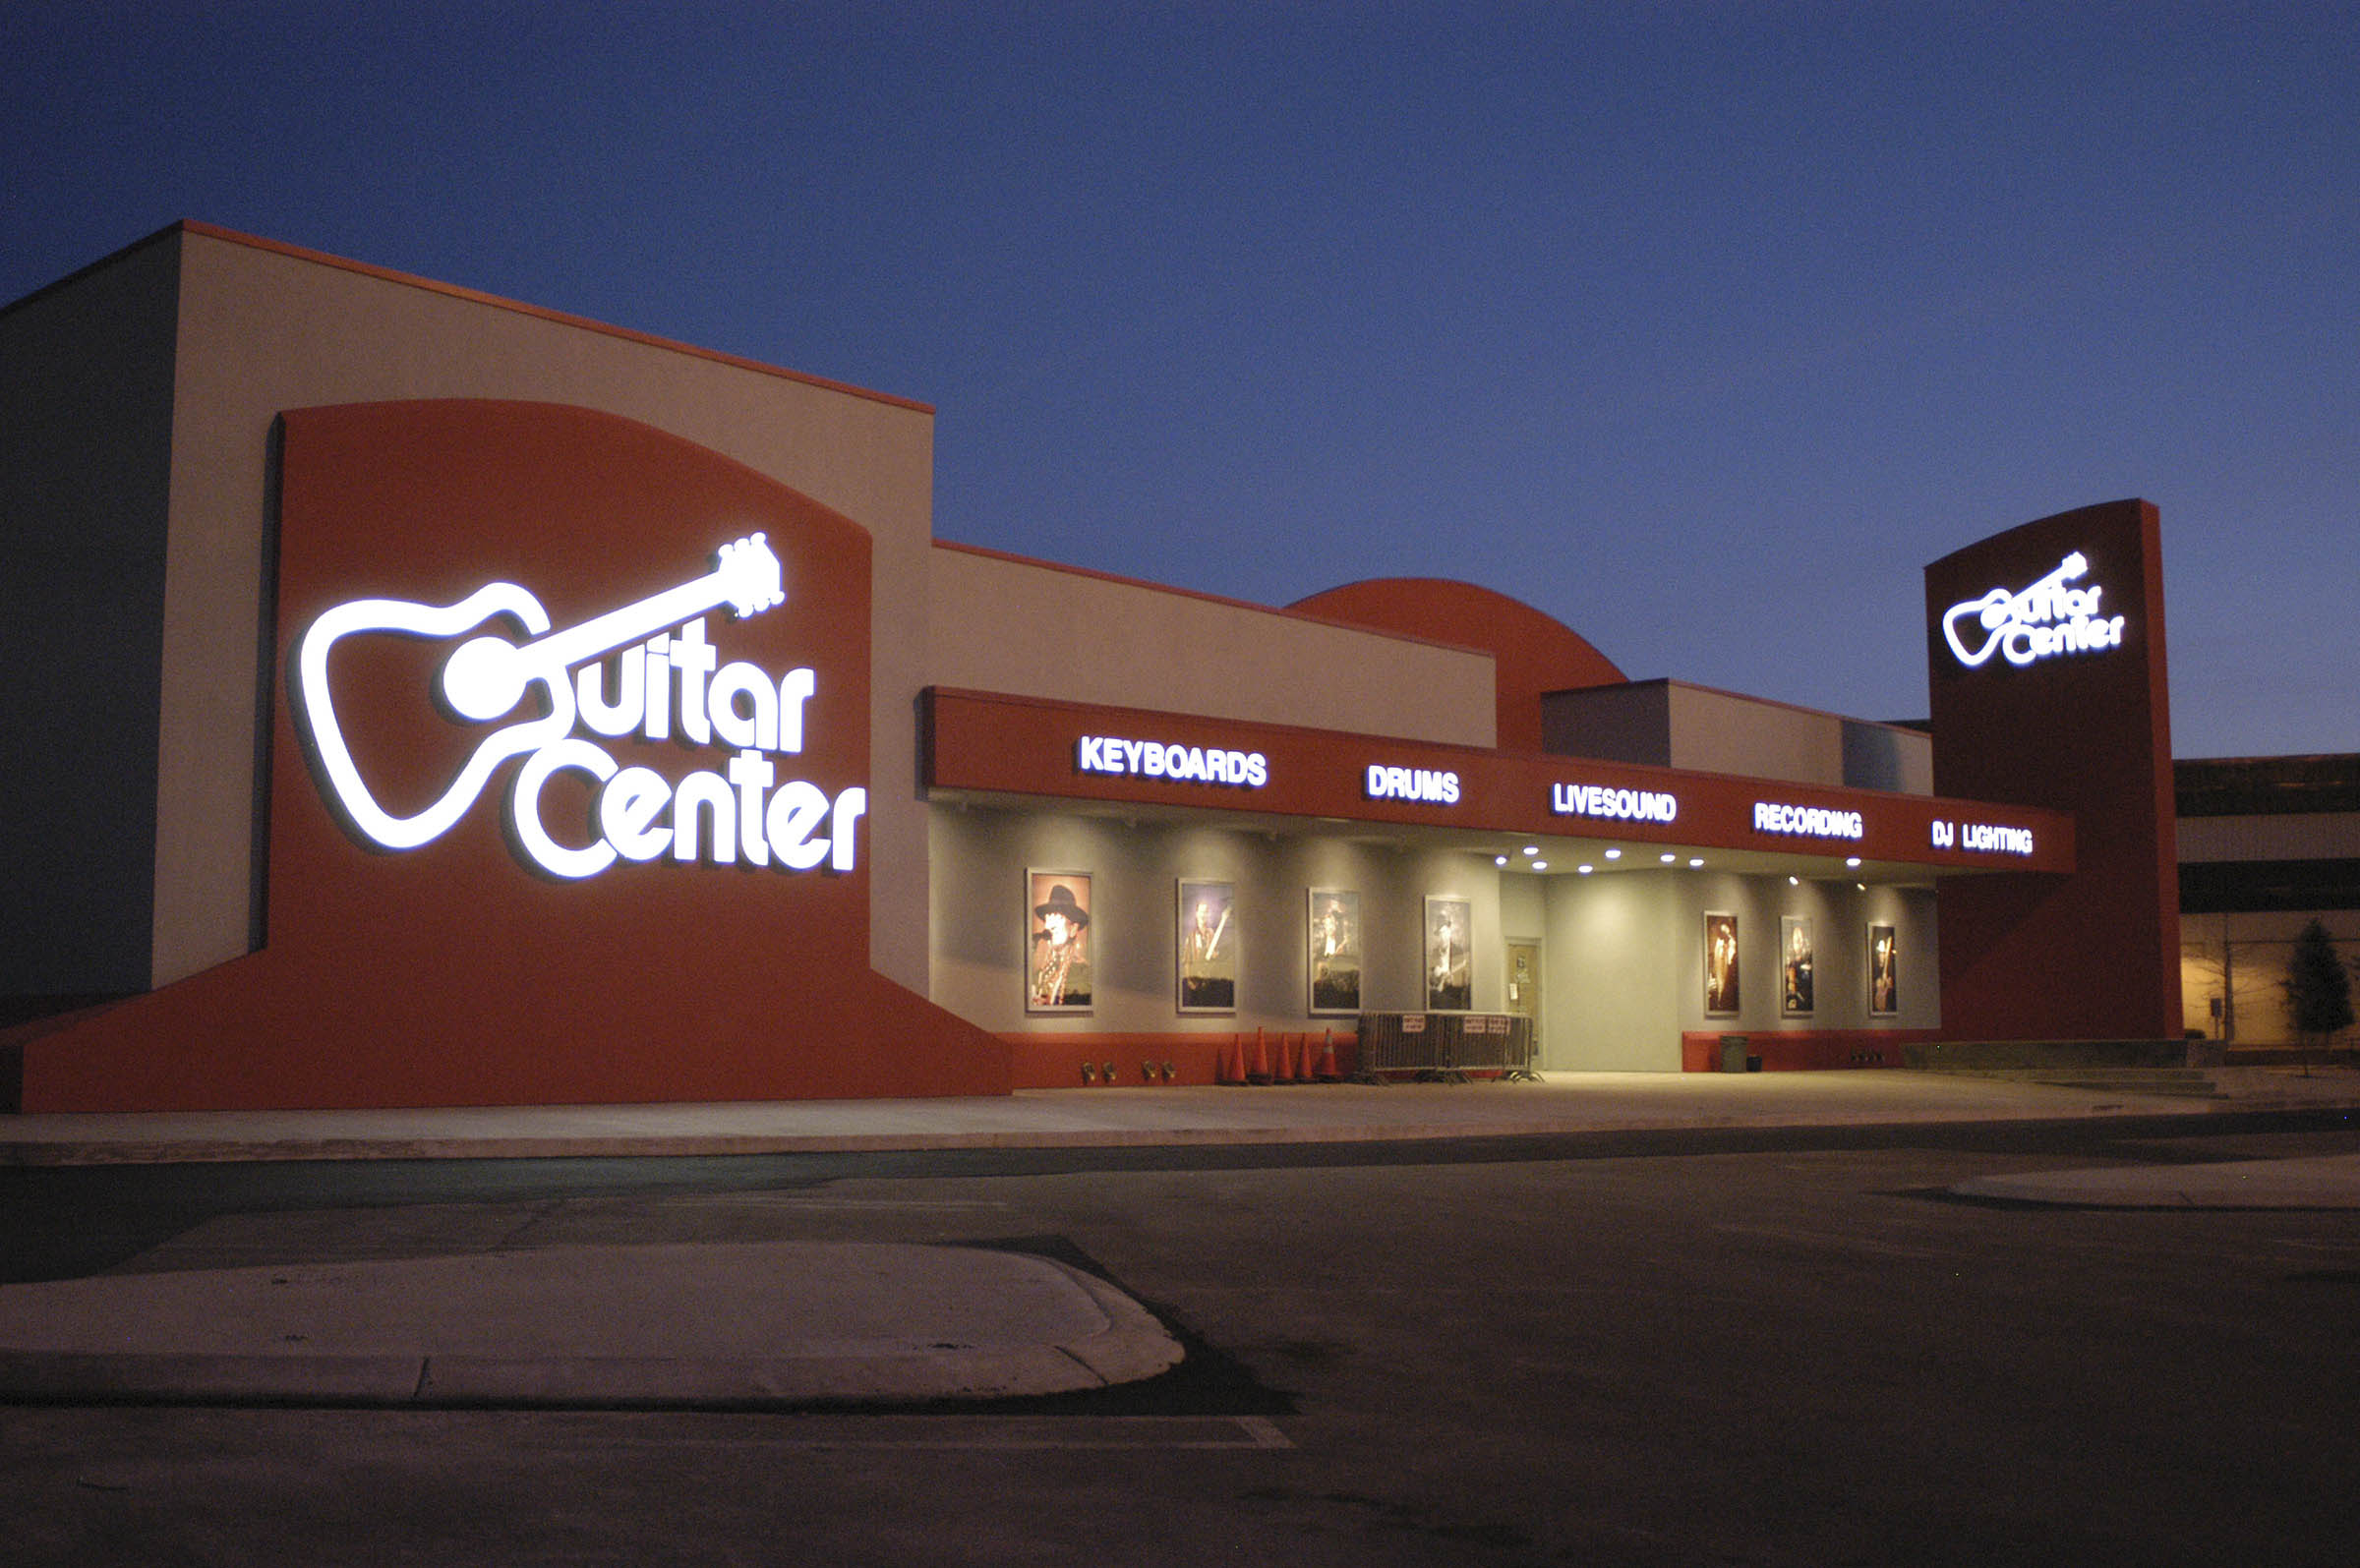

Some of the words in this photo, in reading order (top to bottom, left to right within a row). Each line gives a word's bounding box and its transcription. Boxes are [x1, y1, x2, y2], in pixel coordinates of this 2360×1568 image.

[2002, 616, 2125, 664] Center
[1080, 735, 1268, 786] KEYBOARDS
[1368, 765, 1460, 804] DRUMS
[1553, 783, 1678, 822] LIVESOUND
[514, 738, 865, 878] Center
[1754, 802, 1863, 839] RECORDING
[1931, 820, 1955, 847] DJ
[1962, 825, 2034, 854] LIGHTING
